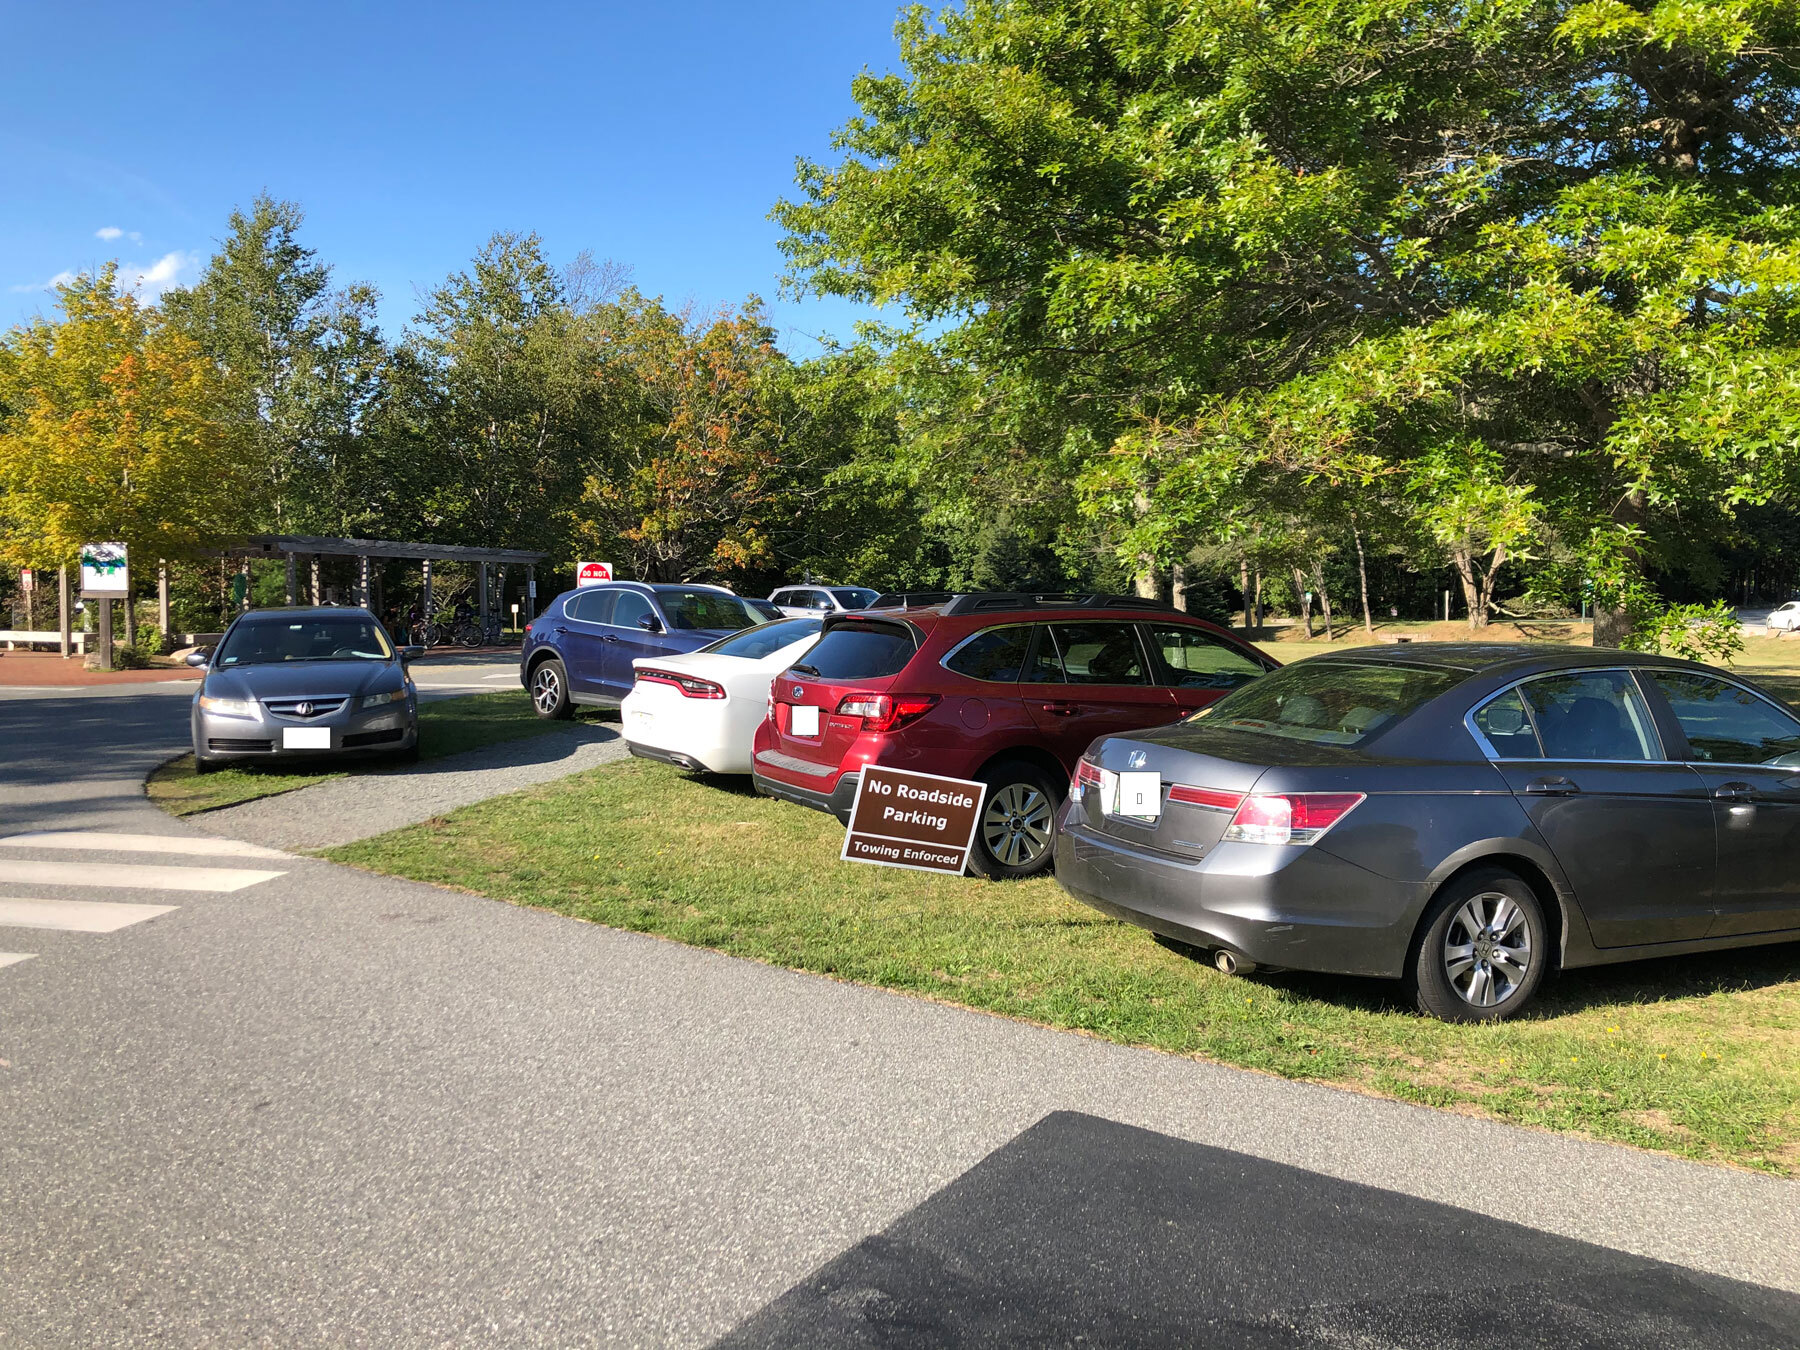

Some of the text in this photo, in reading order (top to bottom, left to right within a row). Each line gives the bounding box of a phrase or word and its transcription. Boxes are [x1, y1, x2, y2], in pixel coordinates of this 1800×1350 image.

[868, 779, 974, 808] No Roadside
[883, 806, 948, 831] Parking
[854, 841, 959, 865] Towing Enforced
